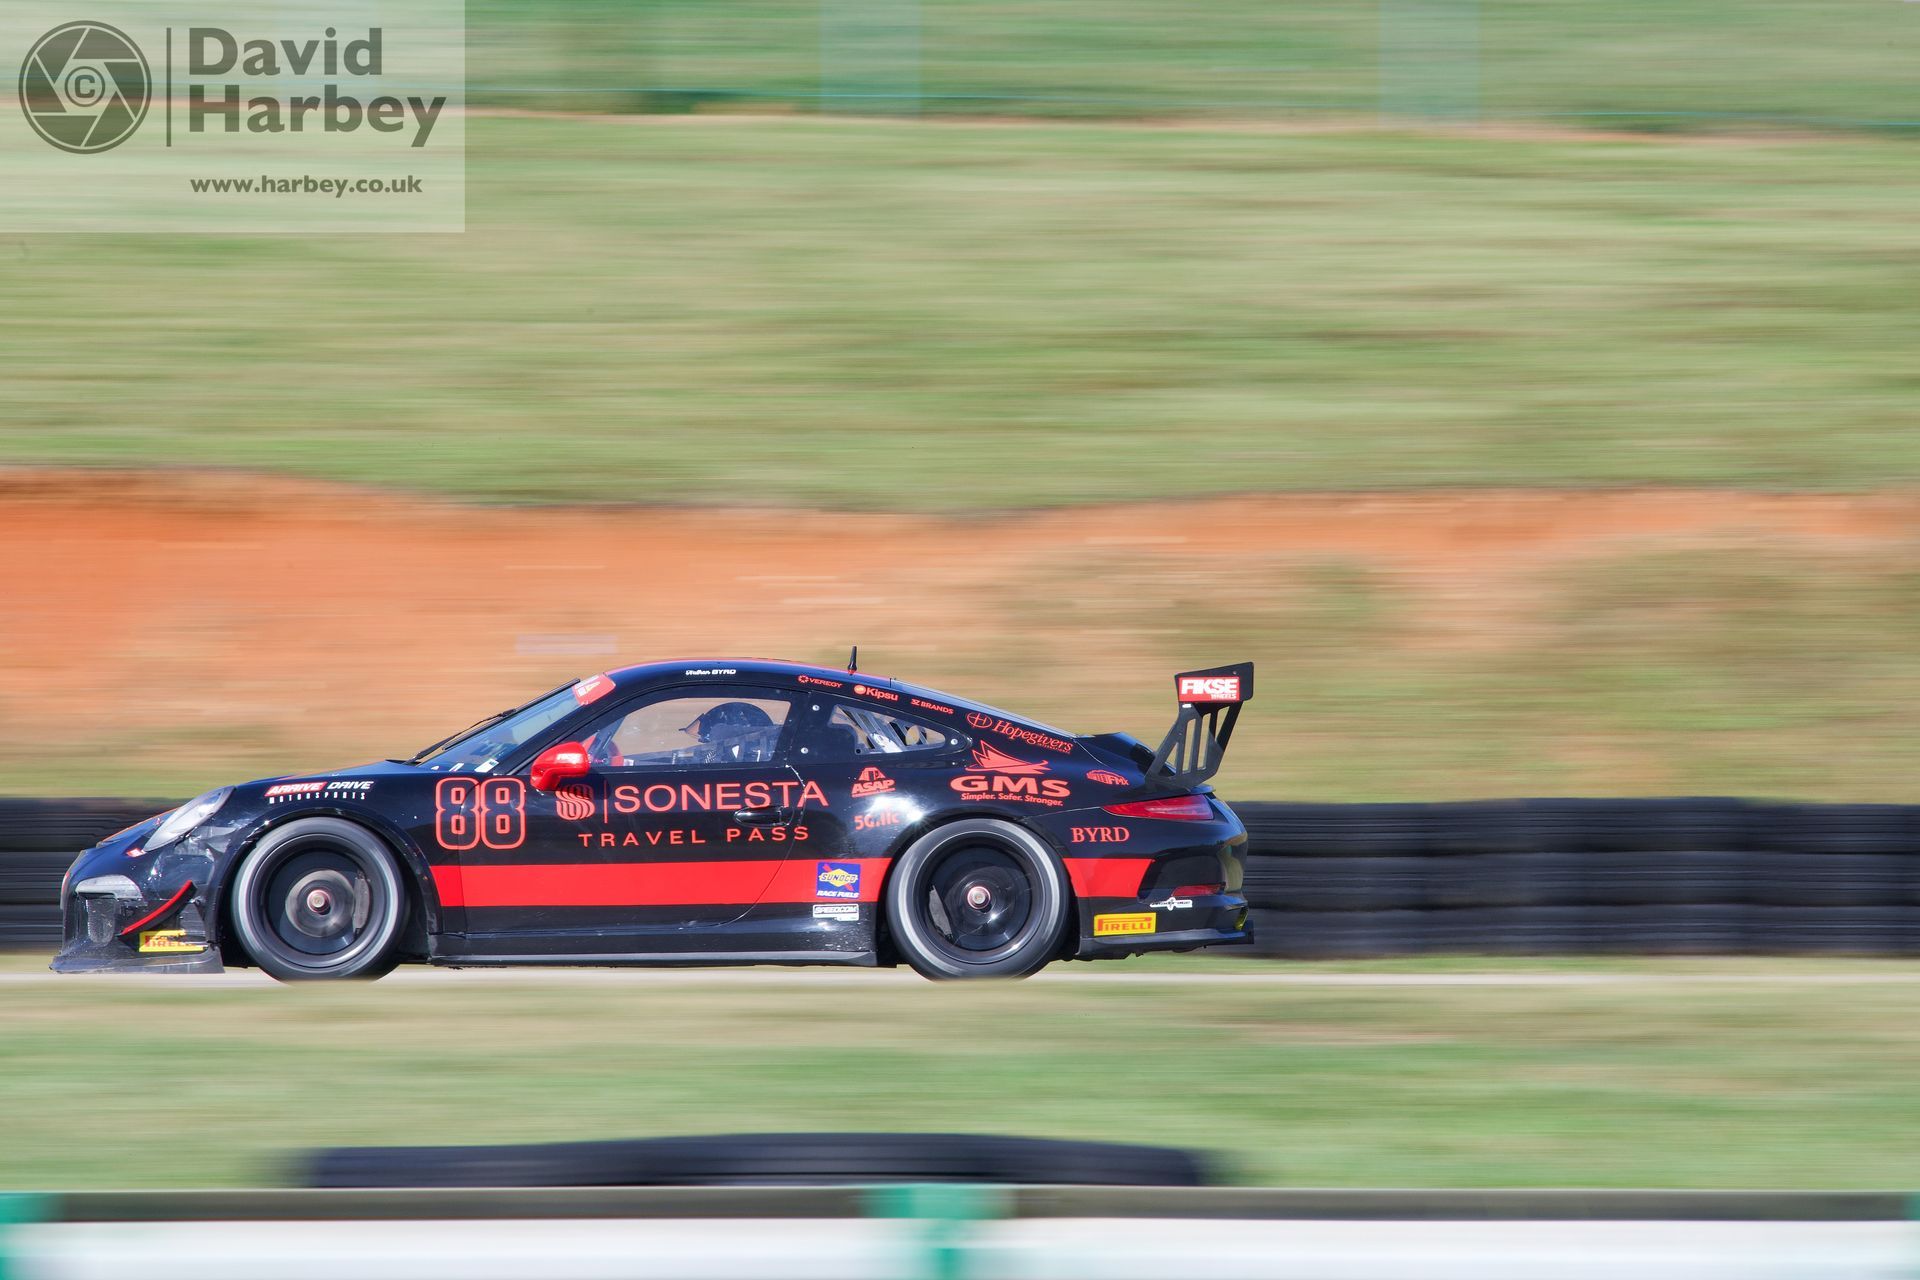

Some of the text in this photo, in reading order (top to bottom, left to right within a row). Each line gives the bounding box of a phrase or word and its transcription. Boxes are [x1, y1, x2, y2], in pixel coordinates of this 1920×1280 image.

[809, 678, 844, 689] VEREGY
[866, 687, 900, 702] Kipsu
[920, 701, 955, 715] BRANDS
[992, 719, 1074, 752] Hopegivers
[267, 781, 375, 795] ARRIVE DRIVE
[851, 779, 896, 794] ASAP
[950, 775, 1071, 798] GMS
[614, 780, 829, 813] SONESTA
[961, 792, 1064, 807] Simpler. Safer. Stronger.
[435, 777, 526, 850] 88
[578, 826, 810, 848] TRAVEL PASS
[1070, 826, 1130, 843] BYRD
[821, 873, 857, 882] SUNOCO
[1097, 917, 1153, 932] PIRELLI
